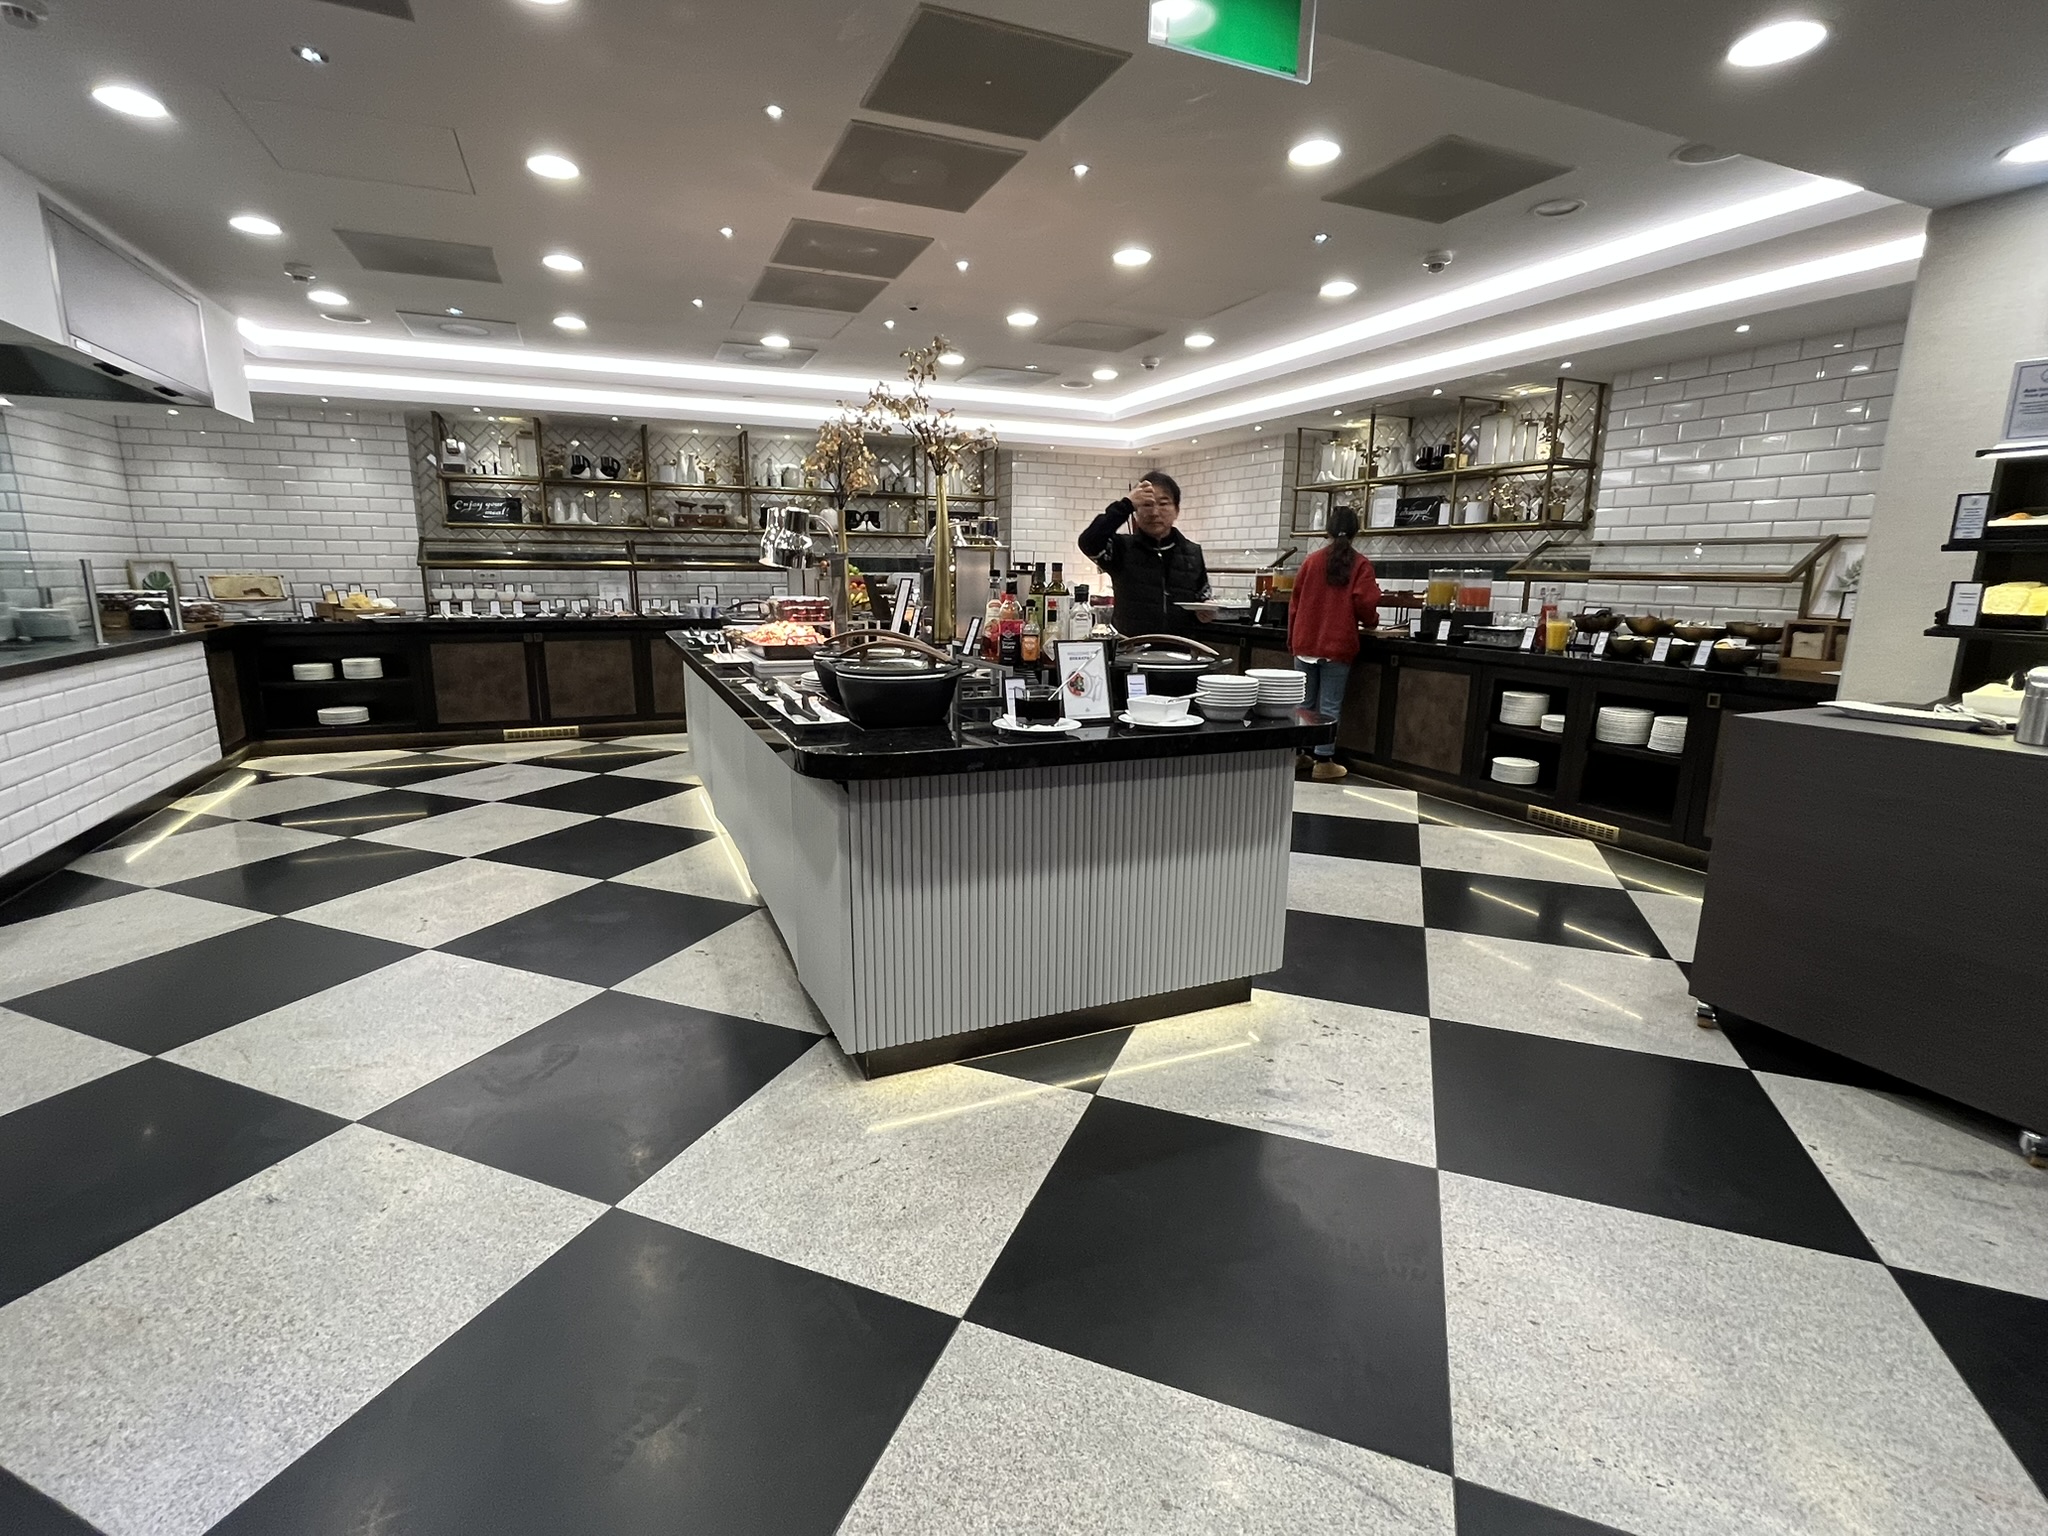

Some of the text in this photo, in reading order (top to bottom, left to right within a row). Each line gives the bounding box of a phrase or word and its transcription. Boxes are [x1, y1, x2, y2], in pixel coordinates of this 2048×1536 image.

[454, 500, 506, 512] Enjoy your
[484, 507, 509, 516] meal!
